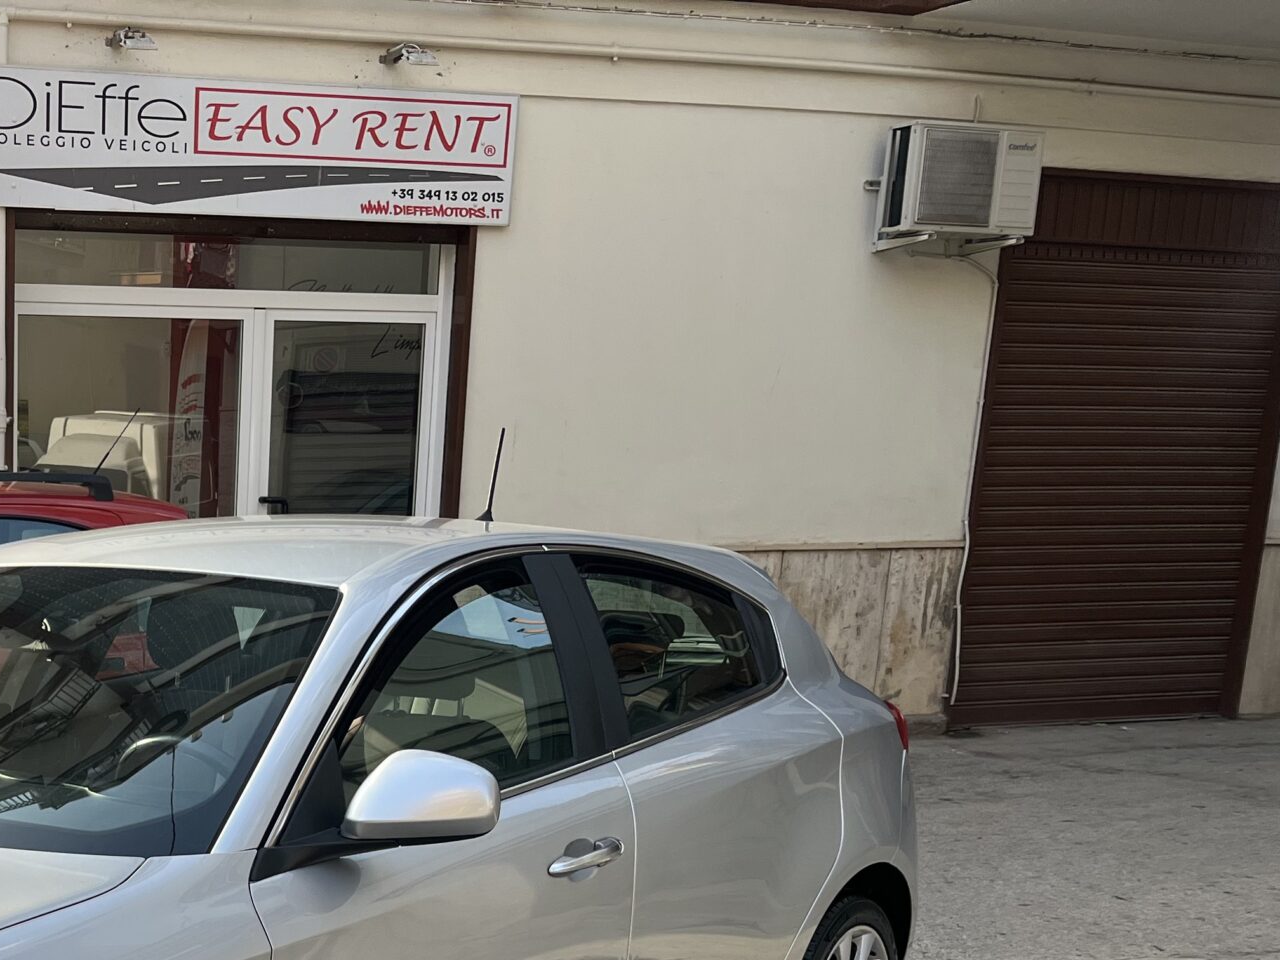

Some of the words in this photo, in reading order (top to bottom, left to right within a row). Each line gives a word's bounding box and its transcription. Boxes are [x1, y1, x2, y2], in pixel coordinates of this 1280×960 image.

[206, 102, 338, 146] EASY
[104, 138, 188, 155] VEICOLI
[391, 188, 414, 199] +39
[418, 189, 441, 200] 349
[445, 190, 457, 201] 13
[461, 191, 478, 202] 02
[482, 192, 504, 203] 015
